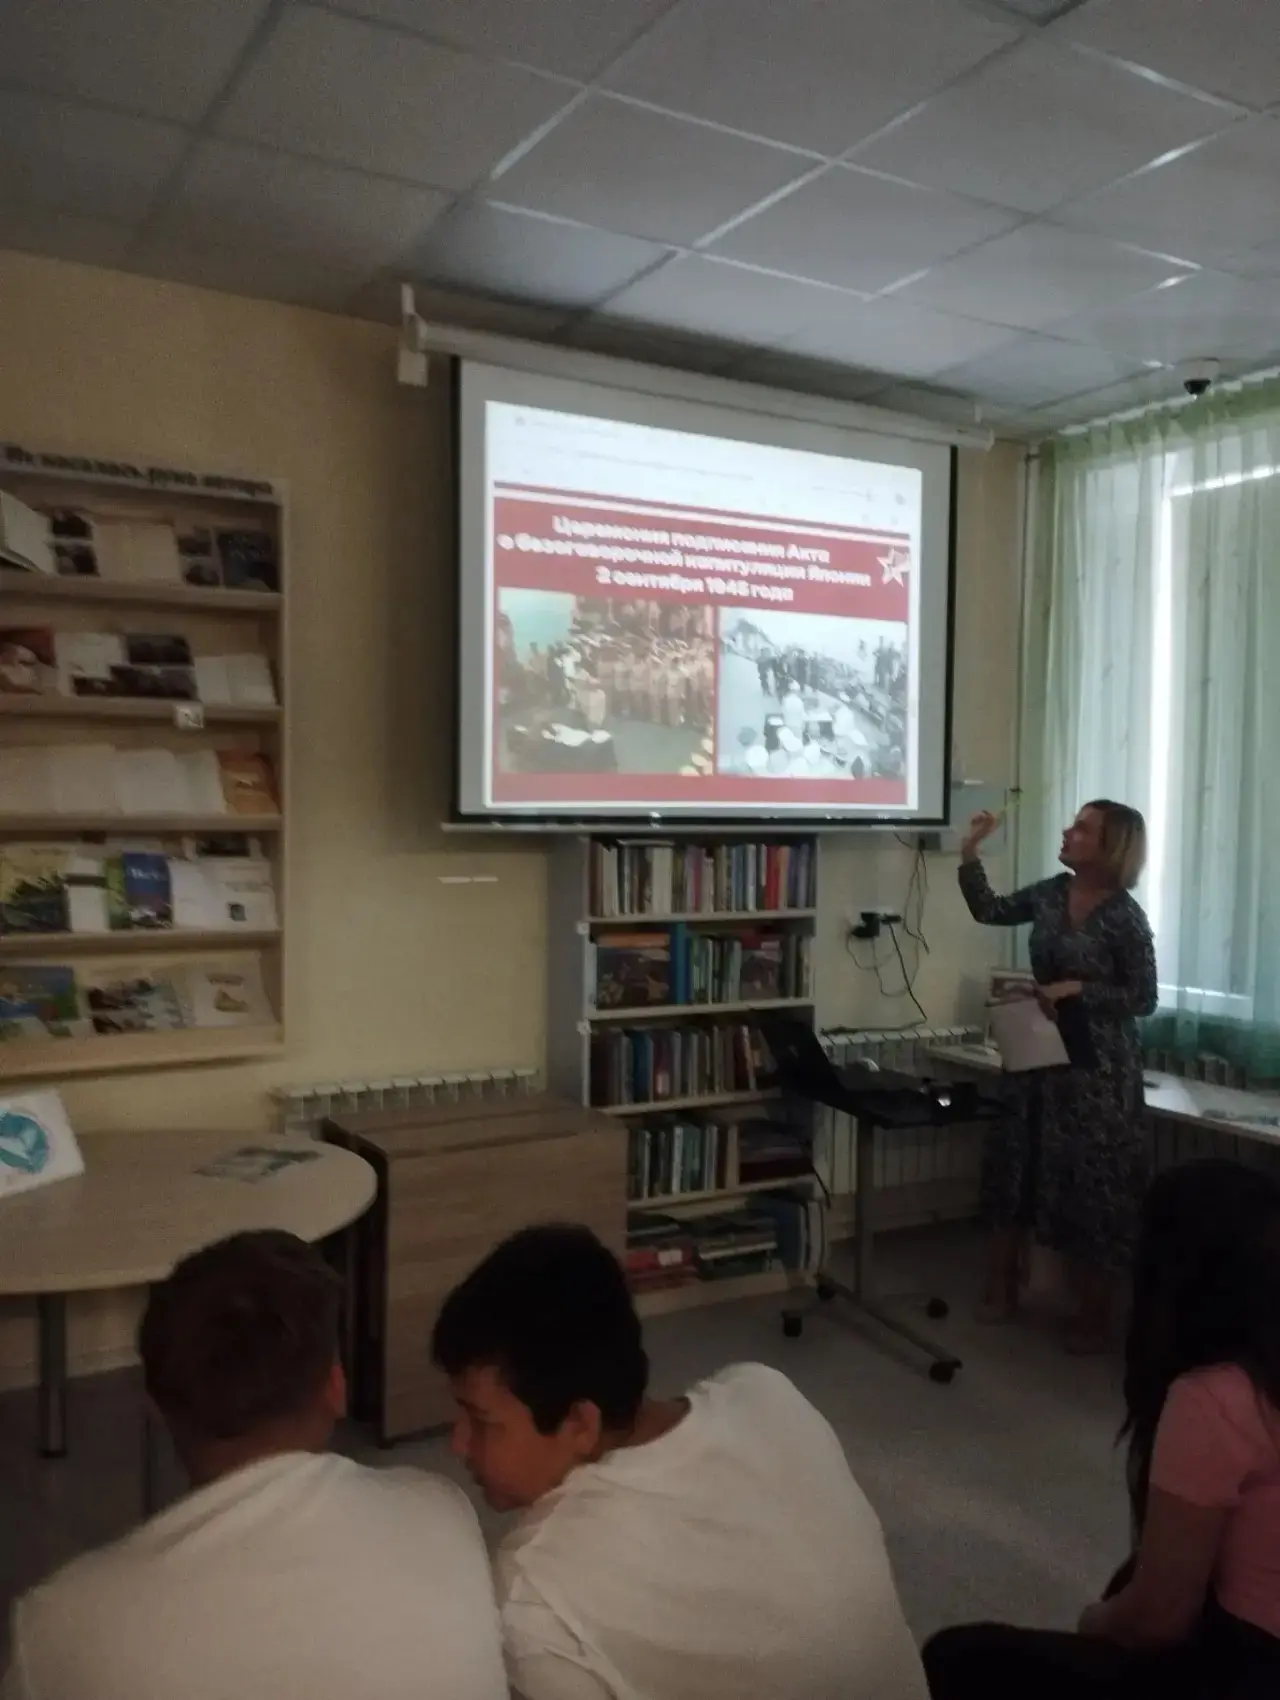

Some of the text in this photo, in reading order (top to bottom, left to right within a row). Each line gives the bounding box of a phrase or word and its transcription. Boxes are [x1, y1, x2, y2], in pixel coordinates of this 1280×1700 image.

[495, 533, 514, 551] о
[684, 554, 806, 580] капитуляции
[807, 564, 871, 587] Японии
[787, 543, 830, 563] Акта
[596, 565, 794, 602] 2 сентября 1945 года
